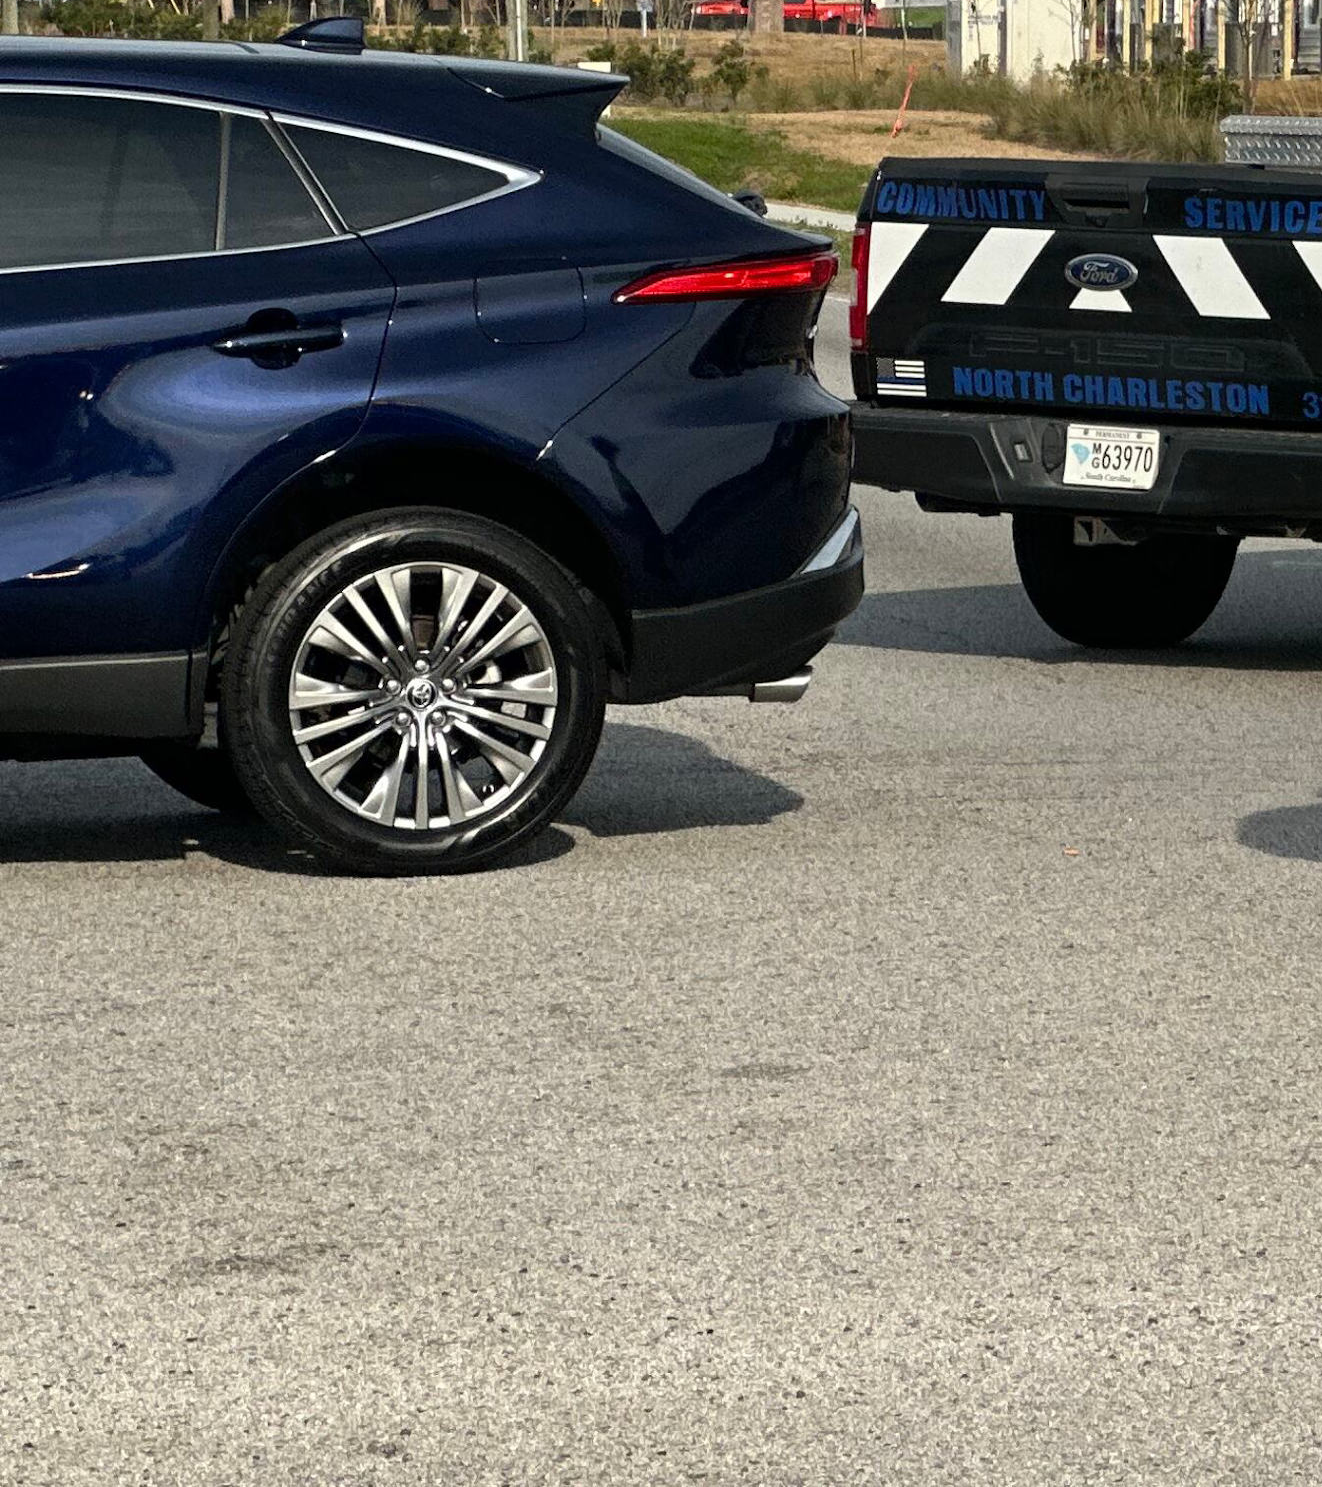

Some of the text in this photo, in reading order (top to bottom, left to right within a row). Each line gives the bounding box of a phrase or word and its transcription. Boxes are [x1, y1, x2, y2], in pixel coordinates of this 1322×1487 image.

[877, 181, 1047, 223] COMMUNITY
[1080, 262, 1121, 286] Ford
[952, 366, 1269, 414] NORTH CHARLESTON
[1102, 444, 1153, 472] 63970
